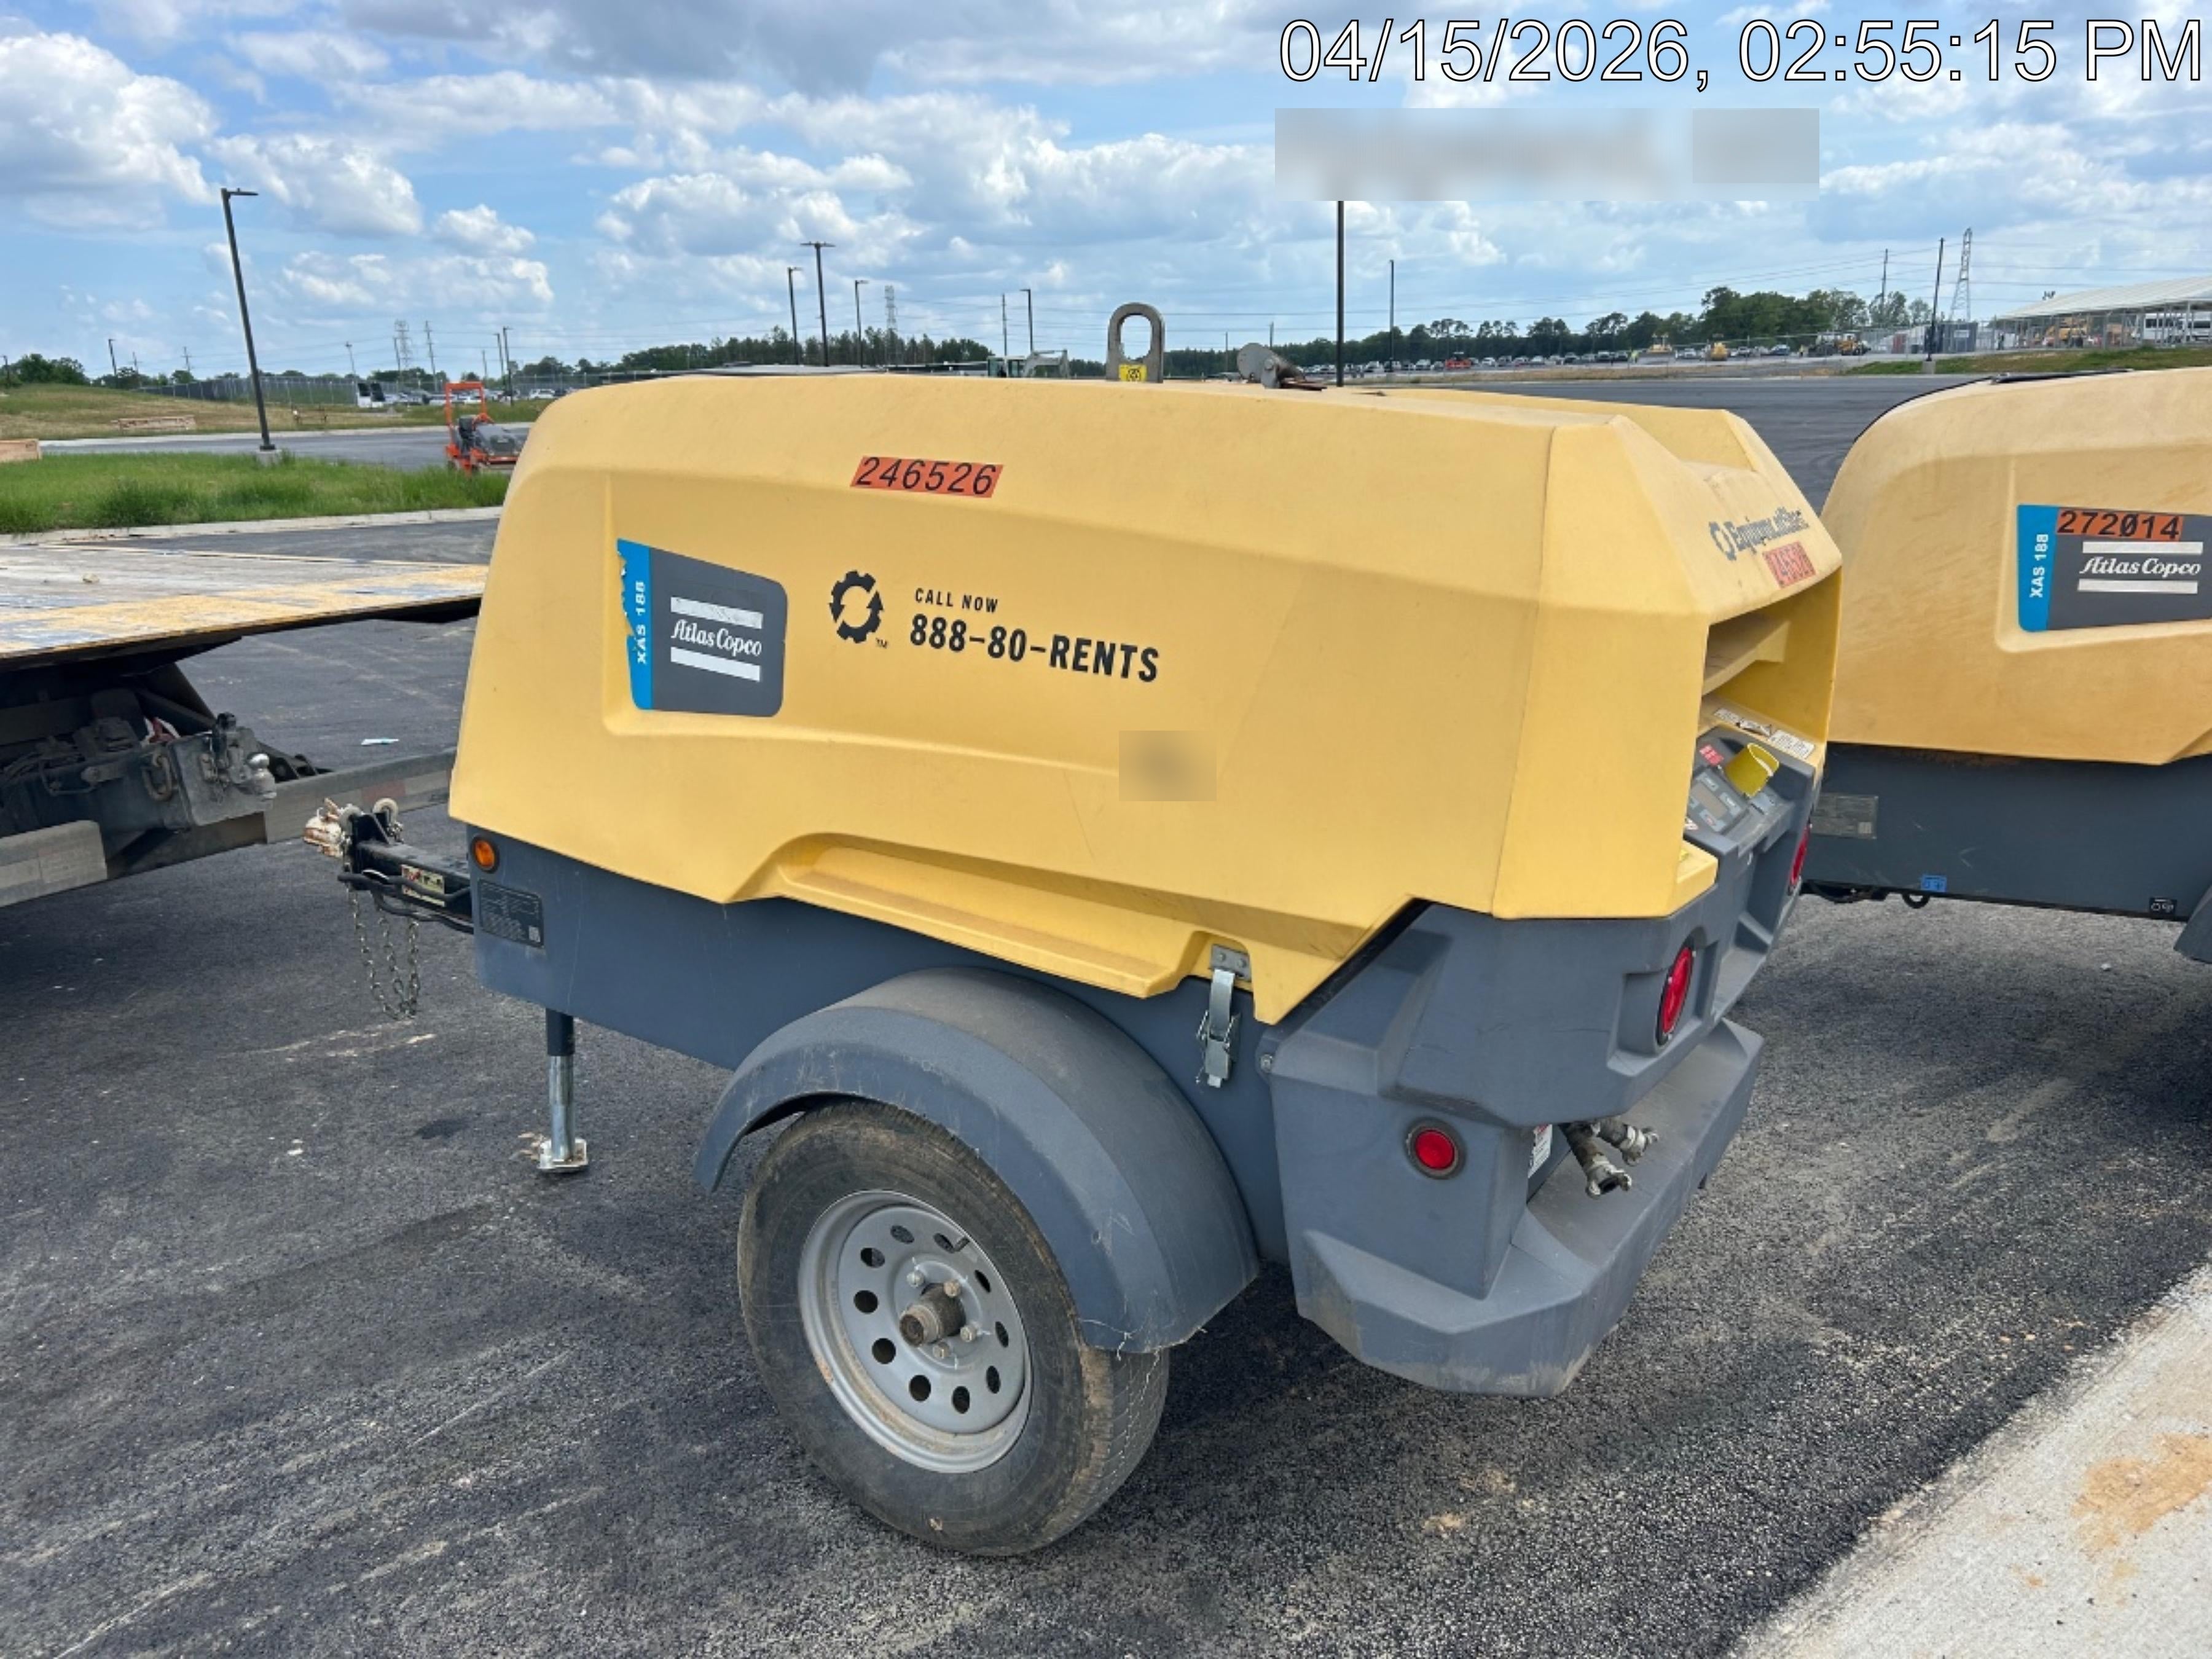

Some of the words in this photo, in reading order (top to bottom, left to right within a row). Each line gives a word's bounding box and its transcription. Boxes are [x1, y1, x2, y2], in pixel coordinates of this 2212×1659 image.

[857, 457, 996, 495] 246526
[2057, 510, 2180, 539] 272014
[2034, 533, 2049, 560] 188
[2029, 567, 2045, 598] XAS
[2079, 556, 2139, 575] Atlas
[2141, 557, 2202, 578] Copco
[635, 580, 646, 616] 188
[915, 588, 954, 608] CALL
[961, 594, 998, 613] NOW
[635, 624, 646, 665] XAS
[670, 618, 715, 648] Atlas
[716, 627, 763, 657] Copco
[909, 613, 1159, 683] 888-80-RENTS
